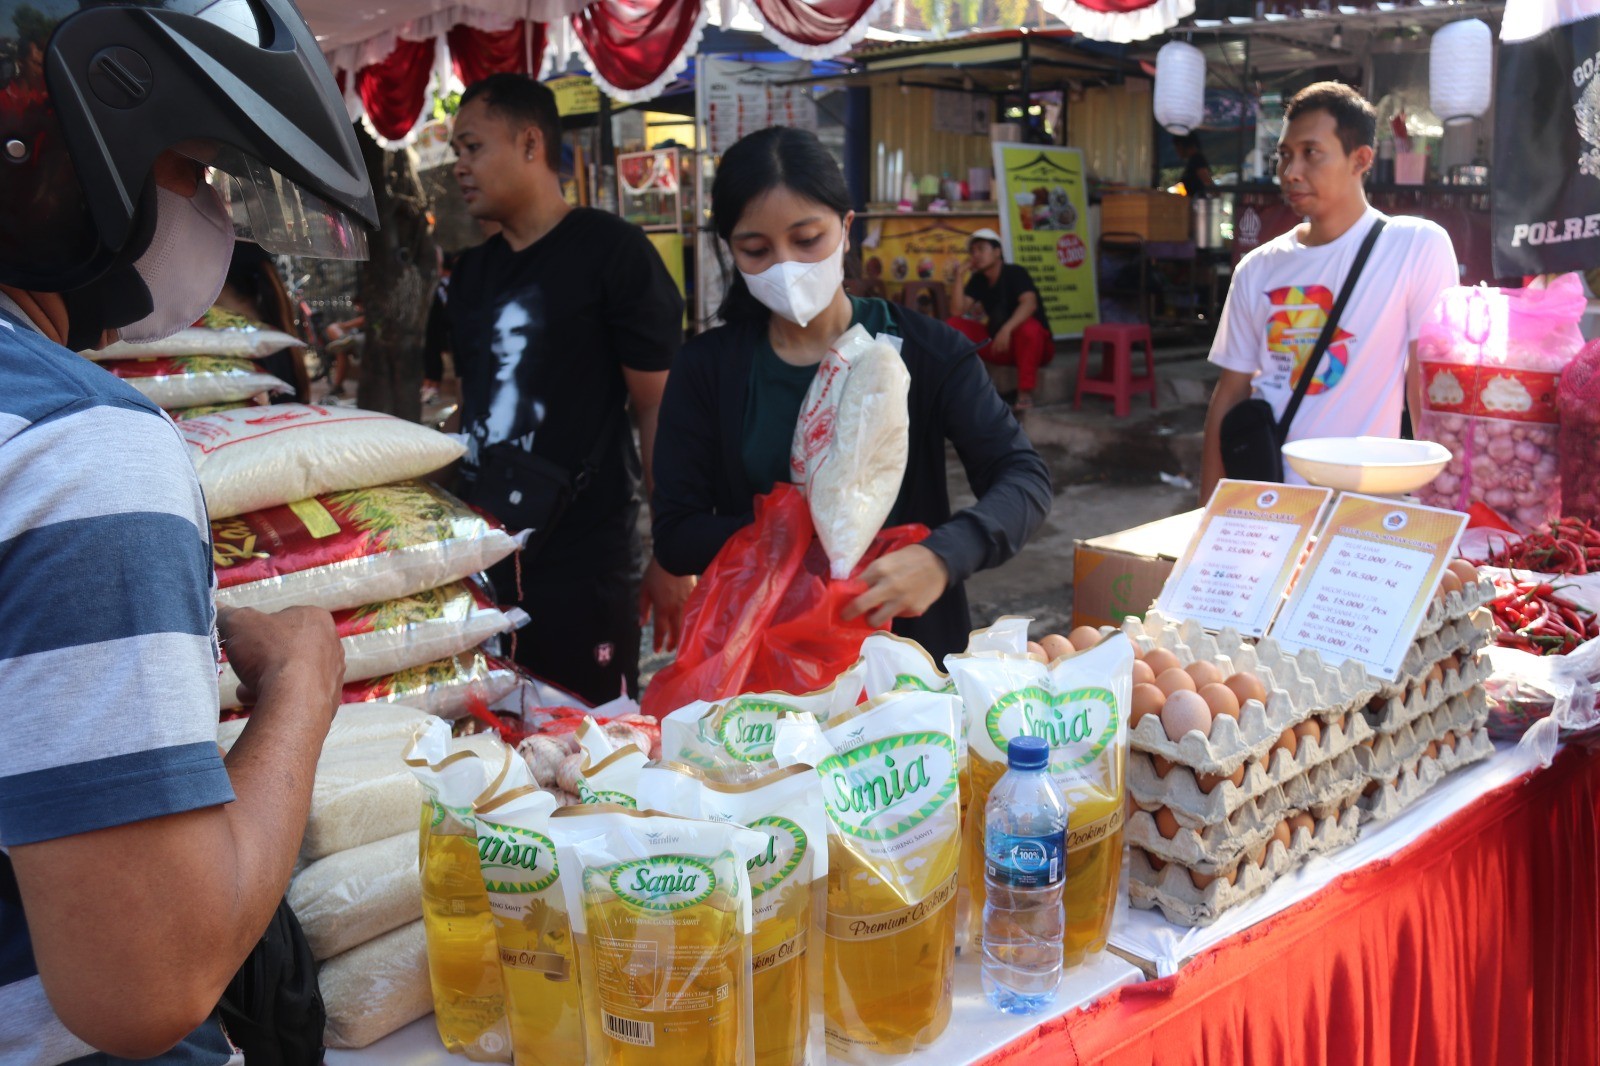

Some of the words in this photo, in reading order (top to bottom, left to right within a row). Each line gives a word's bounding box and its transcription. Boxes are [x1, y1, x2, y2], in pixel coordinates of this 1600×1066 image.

[1385, 579, 1398, 587] Kg
[1371, 606, 1388, 615] Pcs
[1362, 625, 1379, 634] Pcs
[1353, 644, 1370, 654] Pcs
[735, 716, 775, 743] San
[835, 734, 865, 752] wilmar
[834, 754, 930, 813] Sania
[914, 829, 934, 842] SAWIT
[1067, 826, 1105, 848] Cooking
[478, 834, 538, 871] ania
[1019, 851, 1039, 860] 100%
[630, 865, 699, 892] Sania
[505, 904, 521, 912] SAWIT
[850, 912, 908, 936] Premium
[912, 886, 949, 921] Cooking
[682, 918, 700, 926] SAWIT
[778, 941, 795, 957] Oil
[519, 951, 536, 965] Oil
[717, 986, 728, 1000] SNI
